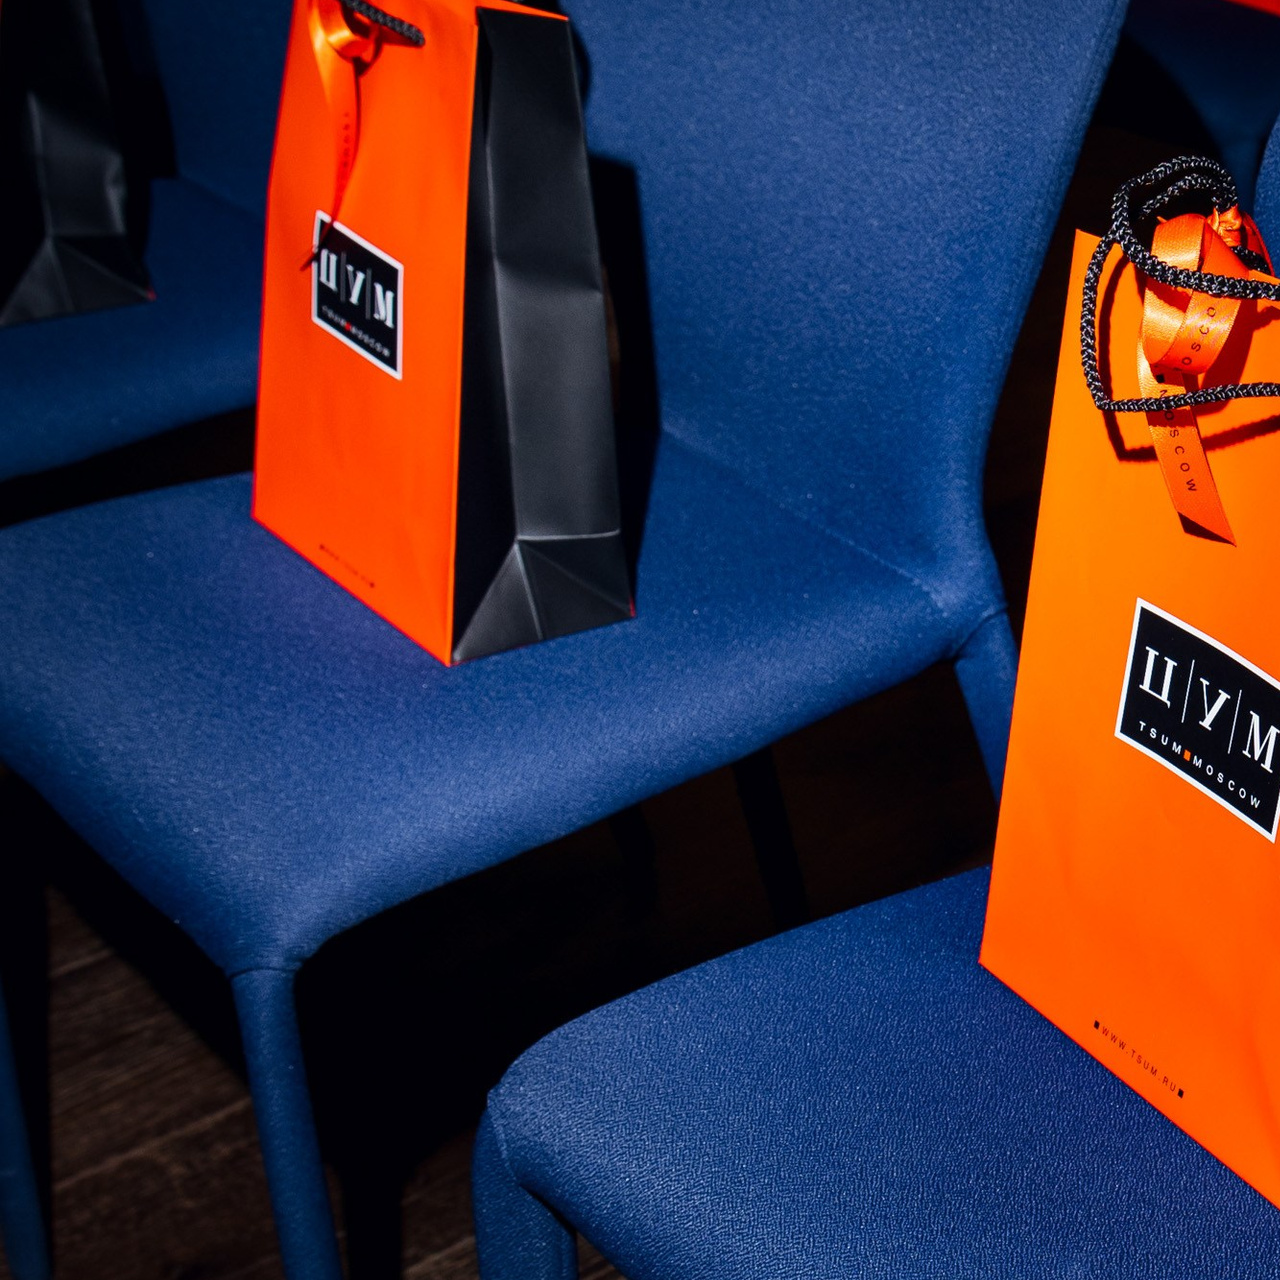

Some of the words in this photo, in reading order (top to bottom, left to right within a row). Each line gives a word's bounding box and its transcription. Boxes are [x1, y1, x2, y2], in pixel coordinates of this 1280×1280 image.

[1174, 306, 1217, 371] OSCO
[1139, 645, 1280, 773] ЦУМ
[1102, 1026, 1177, 1092] WWW.TSUM.RU
